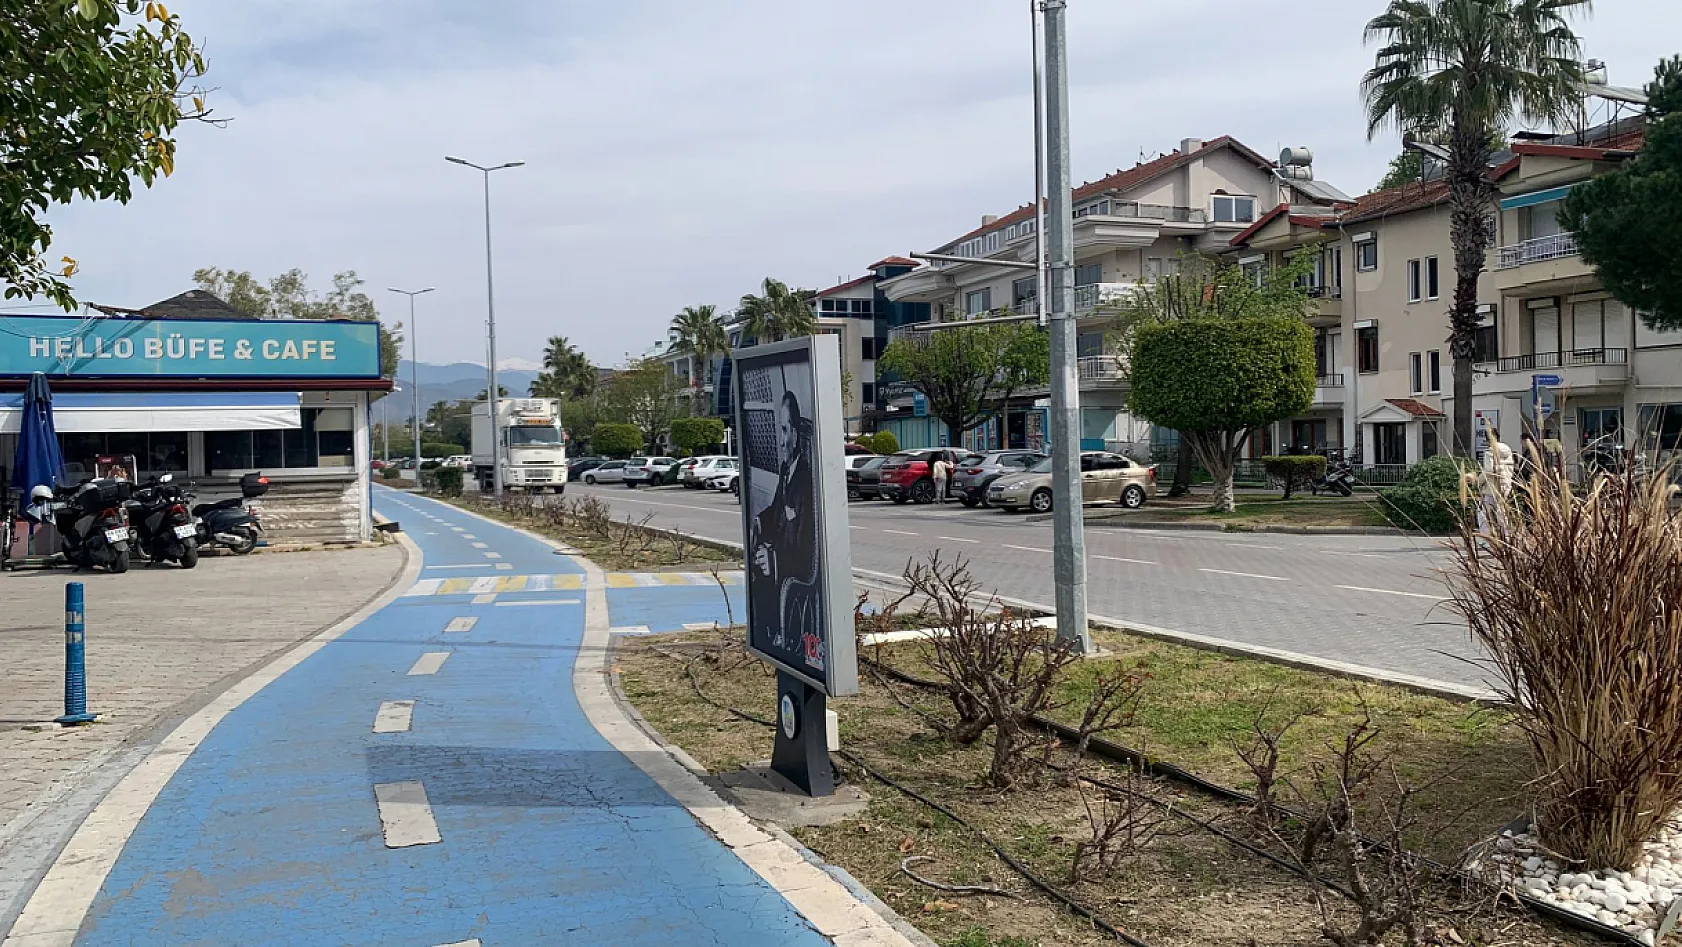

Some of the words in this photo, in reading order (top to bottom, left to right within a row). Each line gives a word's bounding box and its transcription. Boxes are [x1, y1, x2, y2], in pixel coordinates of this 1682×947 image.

[29, 336, 134, 358] HELLO
[144, 333, 225, 359] BÜFE
[233, 338, 254, 360] &
[262, 338, 336, 360] CAFE
